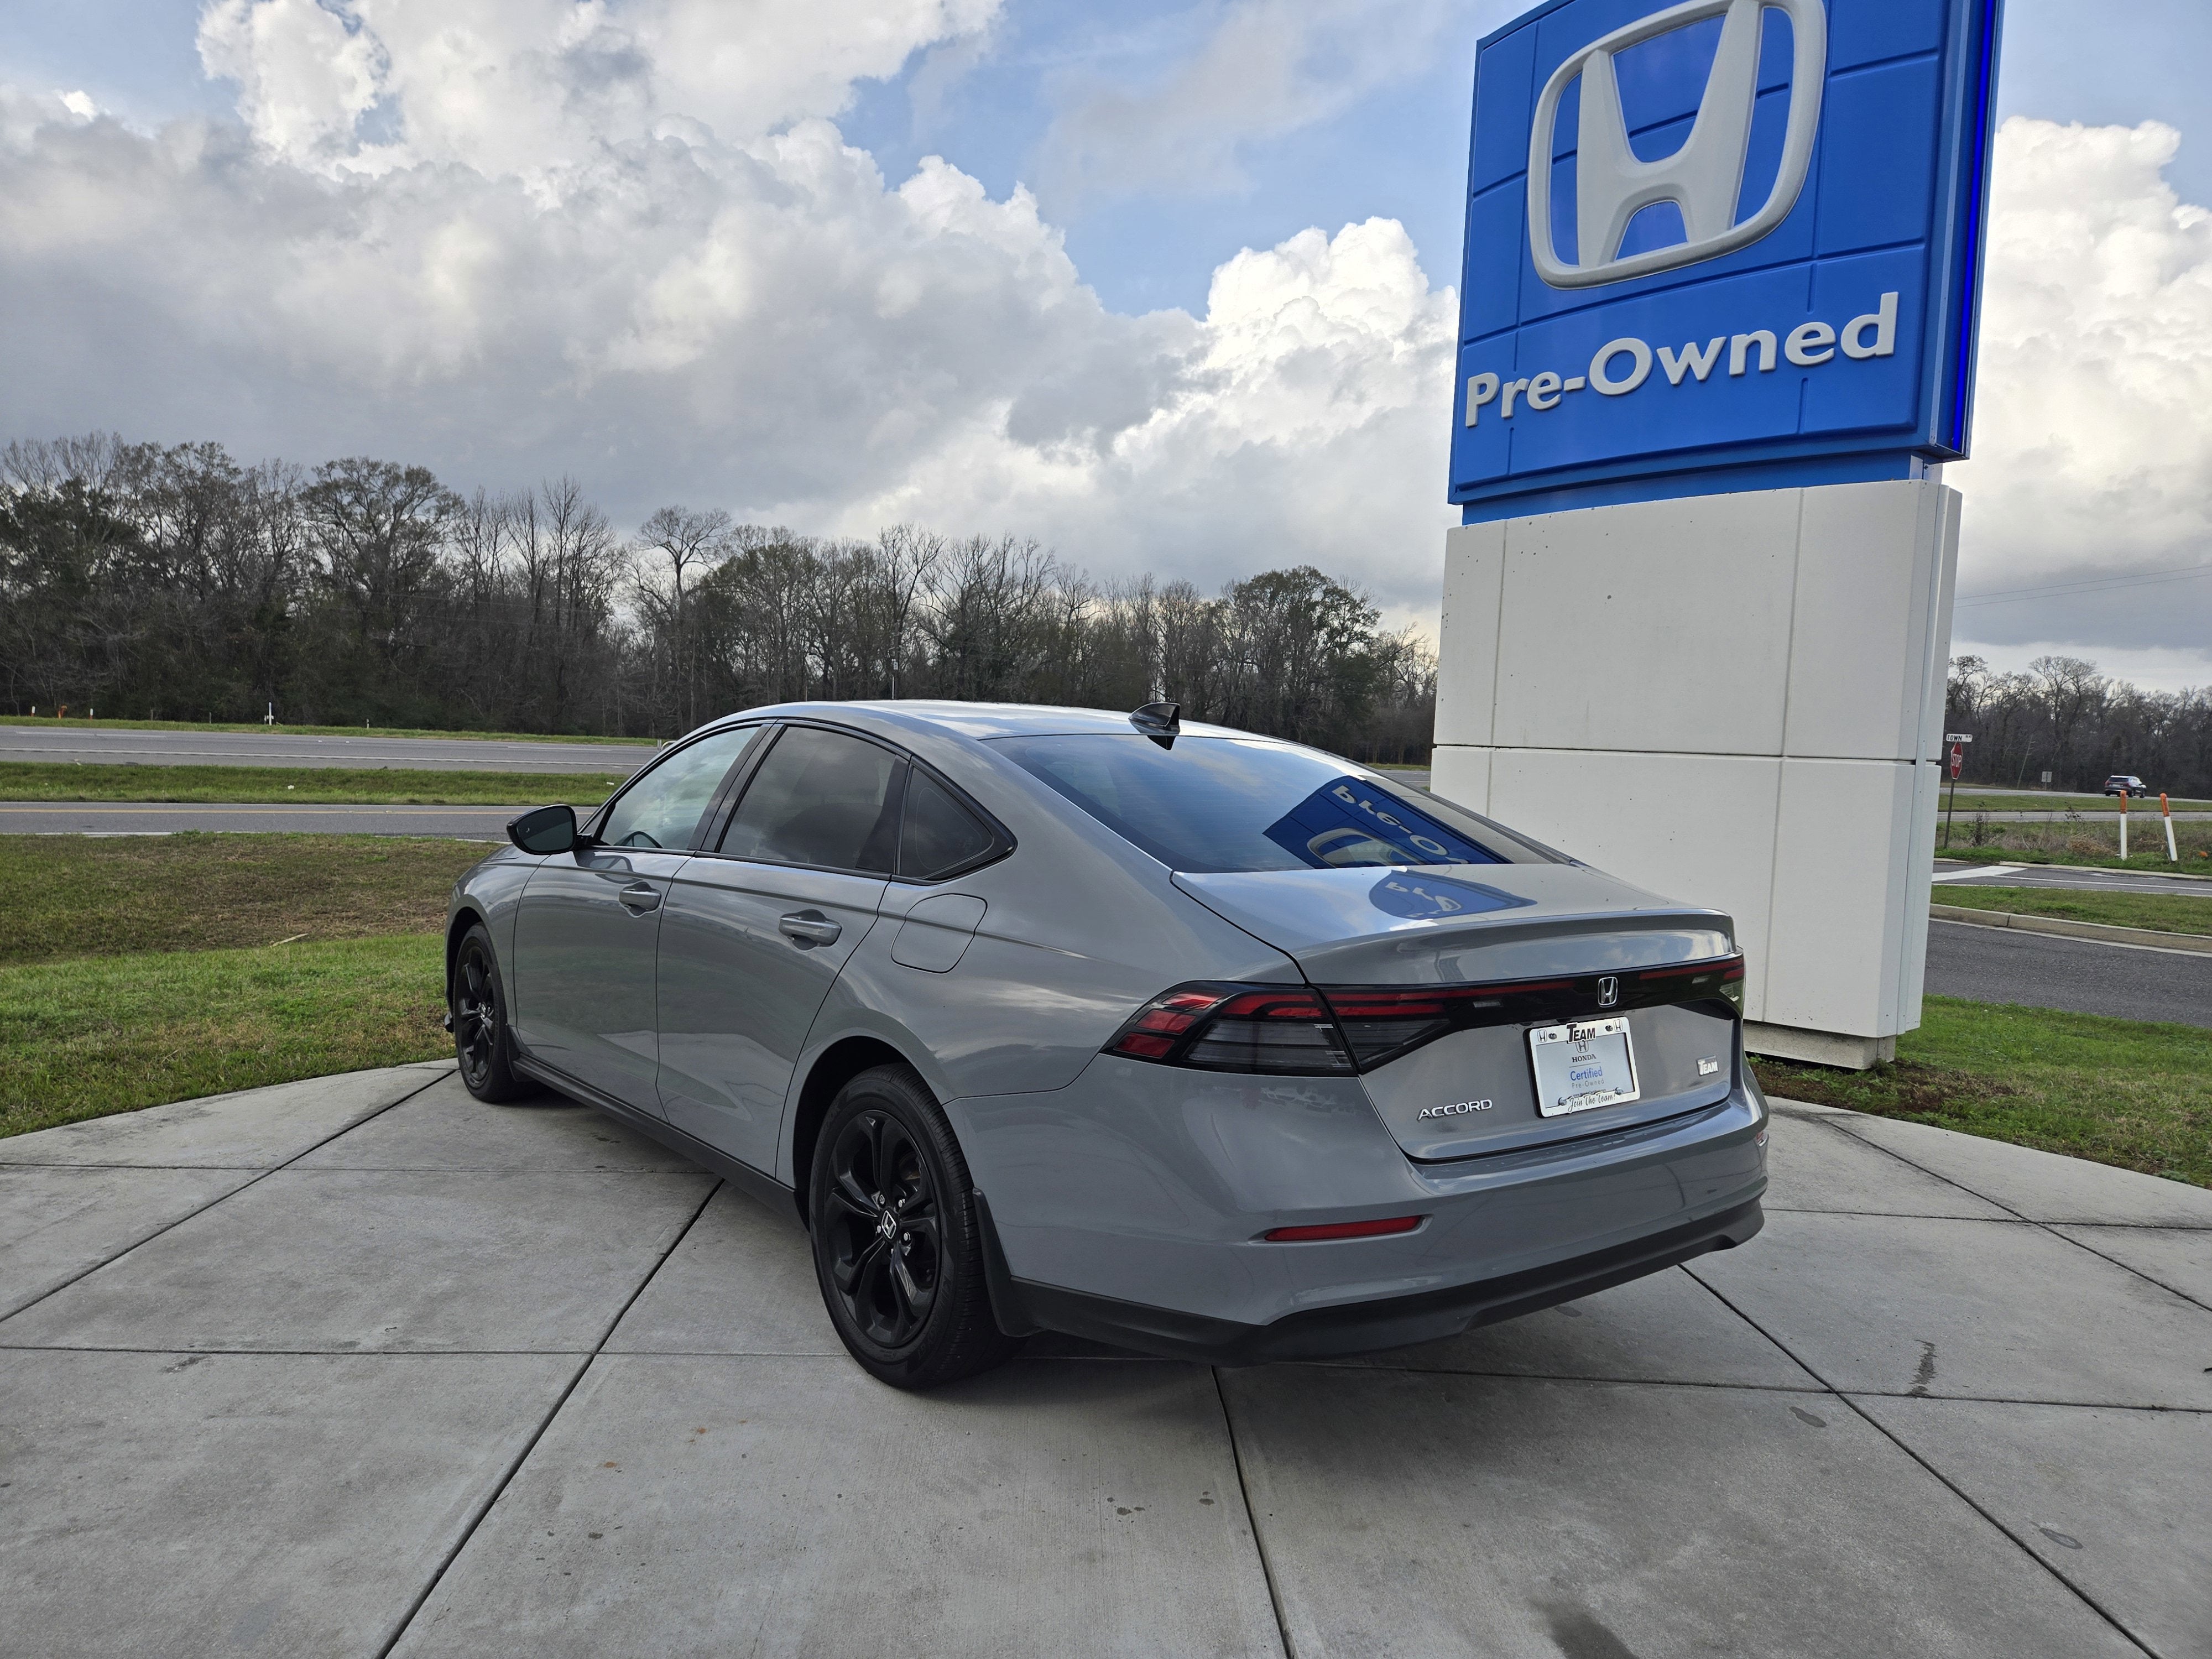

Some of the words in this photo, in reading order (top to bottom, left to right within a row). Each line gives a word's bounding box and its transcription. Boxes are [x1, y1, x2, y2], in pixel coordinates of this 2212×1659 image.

[1464, 291, 1900, 428] Pre-Owned
[1952, 753, 1963, 768] STOP
[1566, 1023, 1595, 1042] TEAM
[1572, 1053, 1597, 1063] HONDA
[1698, 1058, 1718, 1075] TEAM
[1570, 1066, 1603, 1081] Certified
[1572, 1078, 1605, 1089] Pre-Owned
[1417, 1099, 1493, 1120] ACCORD
[1567, 1097, 1583, 1112] Join
[1583, 1094, 1596, 1106] The
